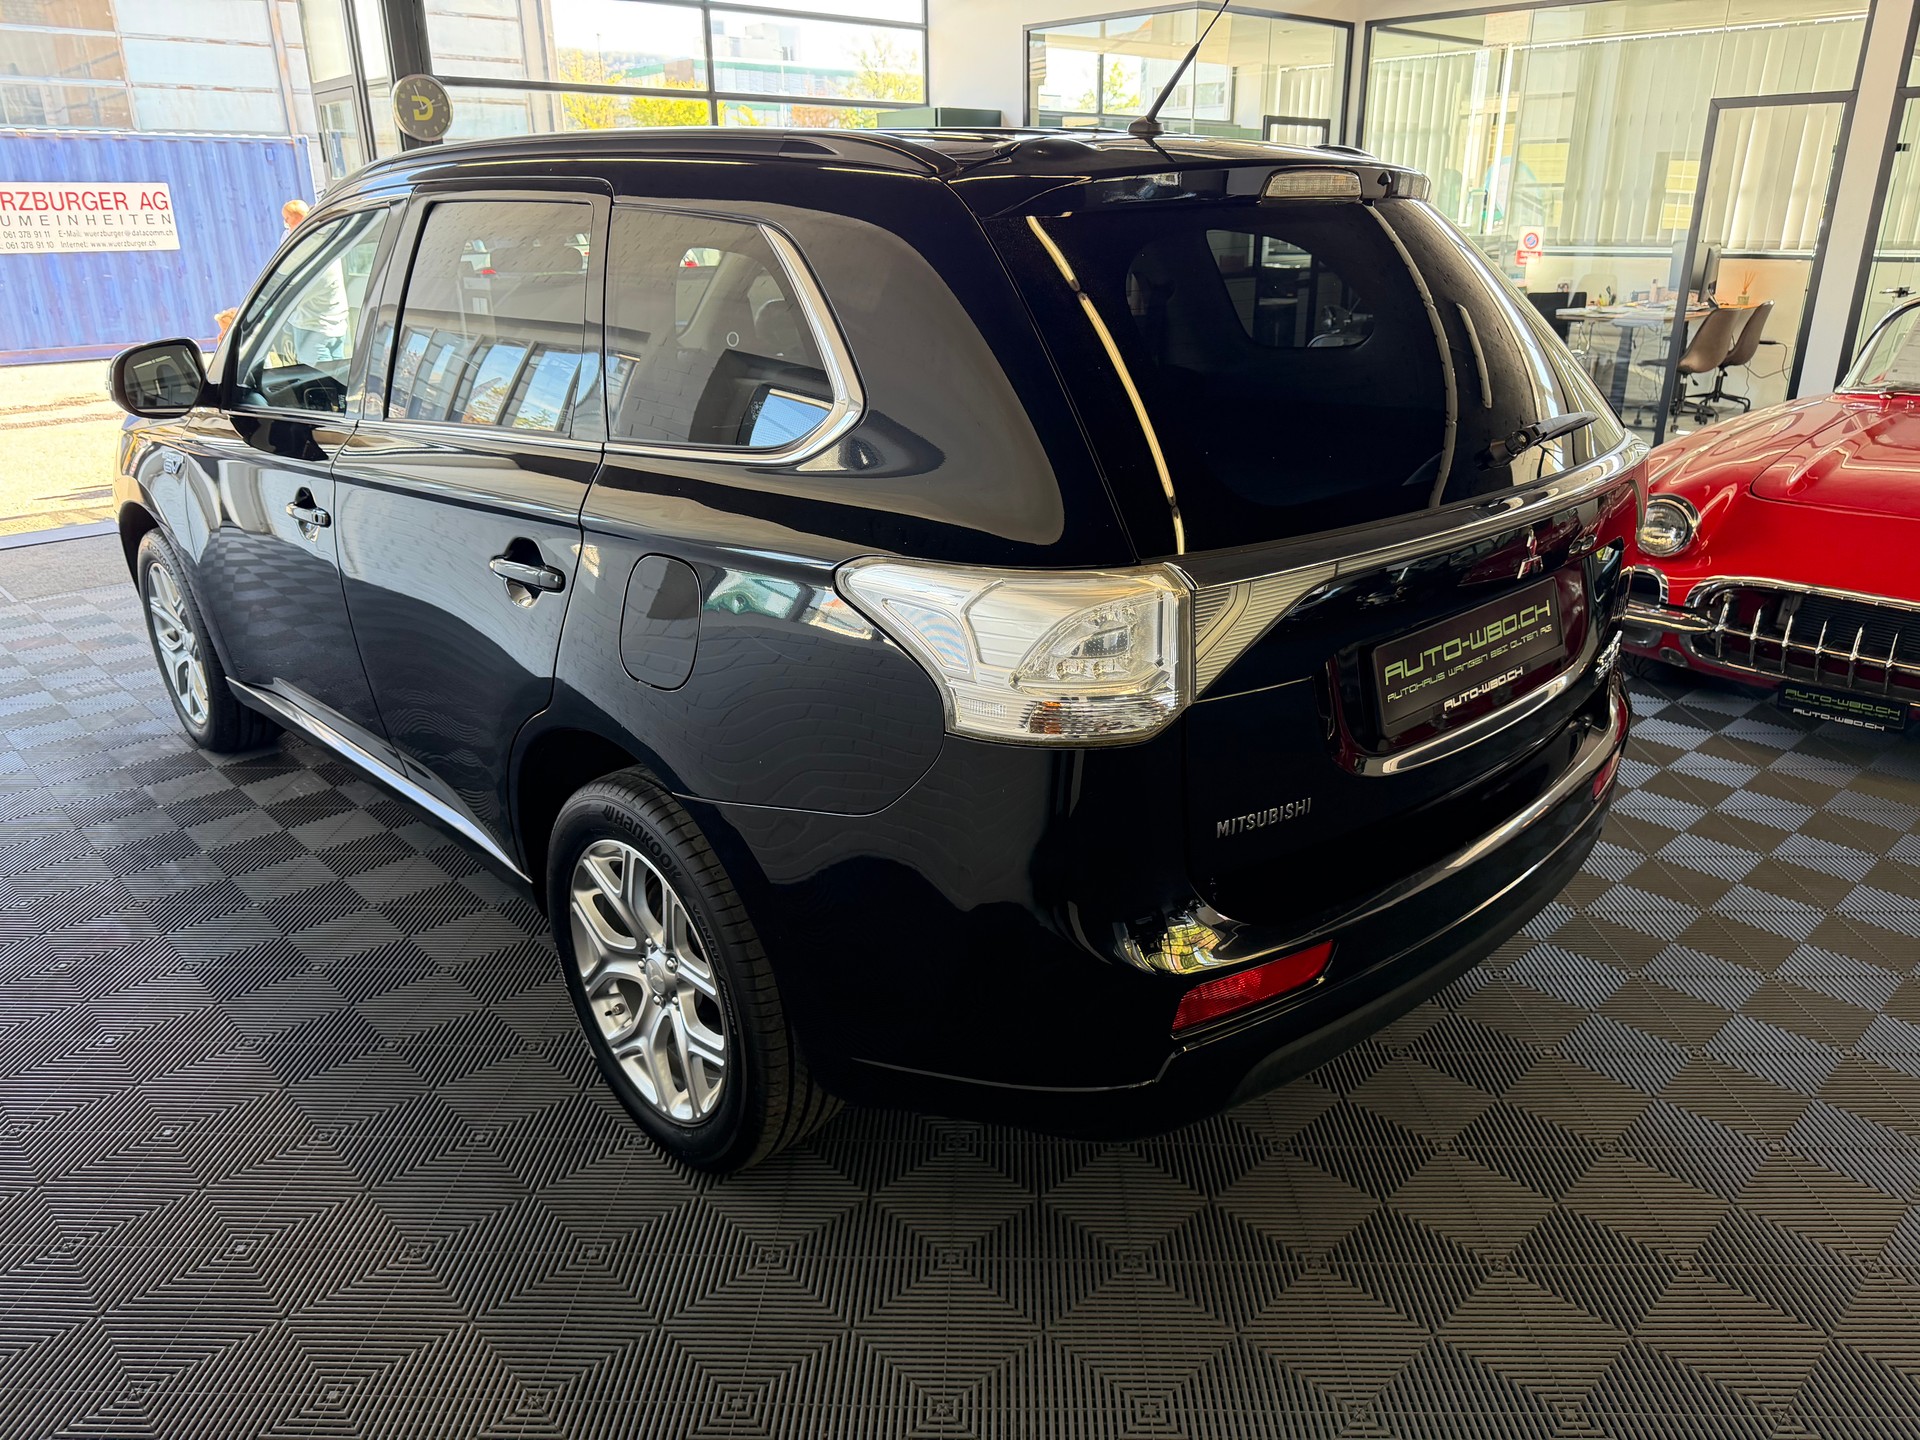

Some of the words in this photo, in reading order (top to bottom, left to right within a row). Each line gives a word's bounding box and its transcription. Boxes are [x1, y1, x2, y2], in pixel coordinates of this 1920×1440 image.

[0, 191, 129, 211] RZBURGER
[140, 191, 169, 211] AG
[0, 214, 172, 227] UMEINHEITEN
[3, 230, 16, 239] 061
[18, 230, 31, 238] 378
[34, 230, 42, 238] 91
[44, 230, 51, 238] 11
[6, 241, 19, 249] 061
[21, 241, 34, 249] 378
[36, 241, 44, 249] 91
[46, 240, 54, 249] 10
[1384, 599, 1551, 686] AUTO-WBO.CH
[1387, 671, 1446, 703] AUTOHAUS
[1490, 643, 1509, 658] BEI
[1510, 630, 1539, 649] OLTEN
[1443, 666, 1524, 712] AUTO-WBO.CH
[1216, 797, 1311, 839] MITSUBISHI
